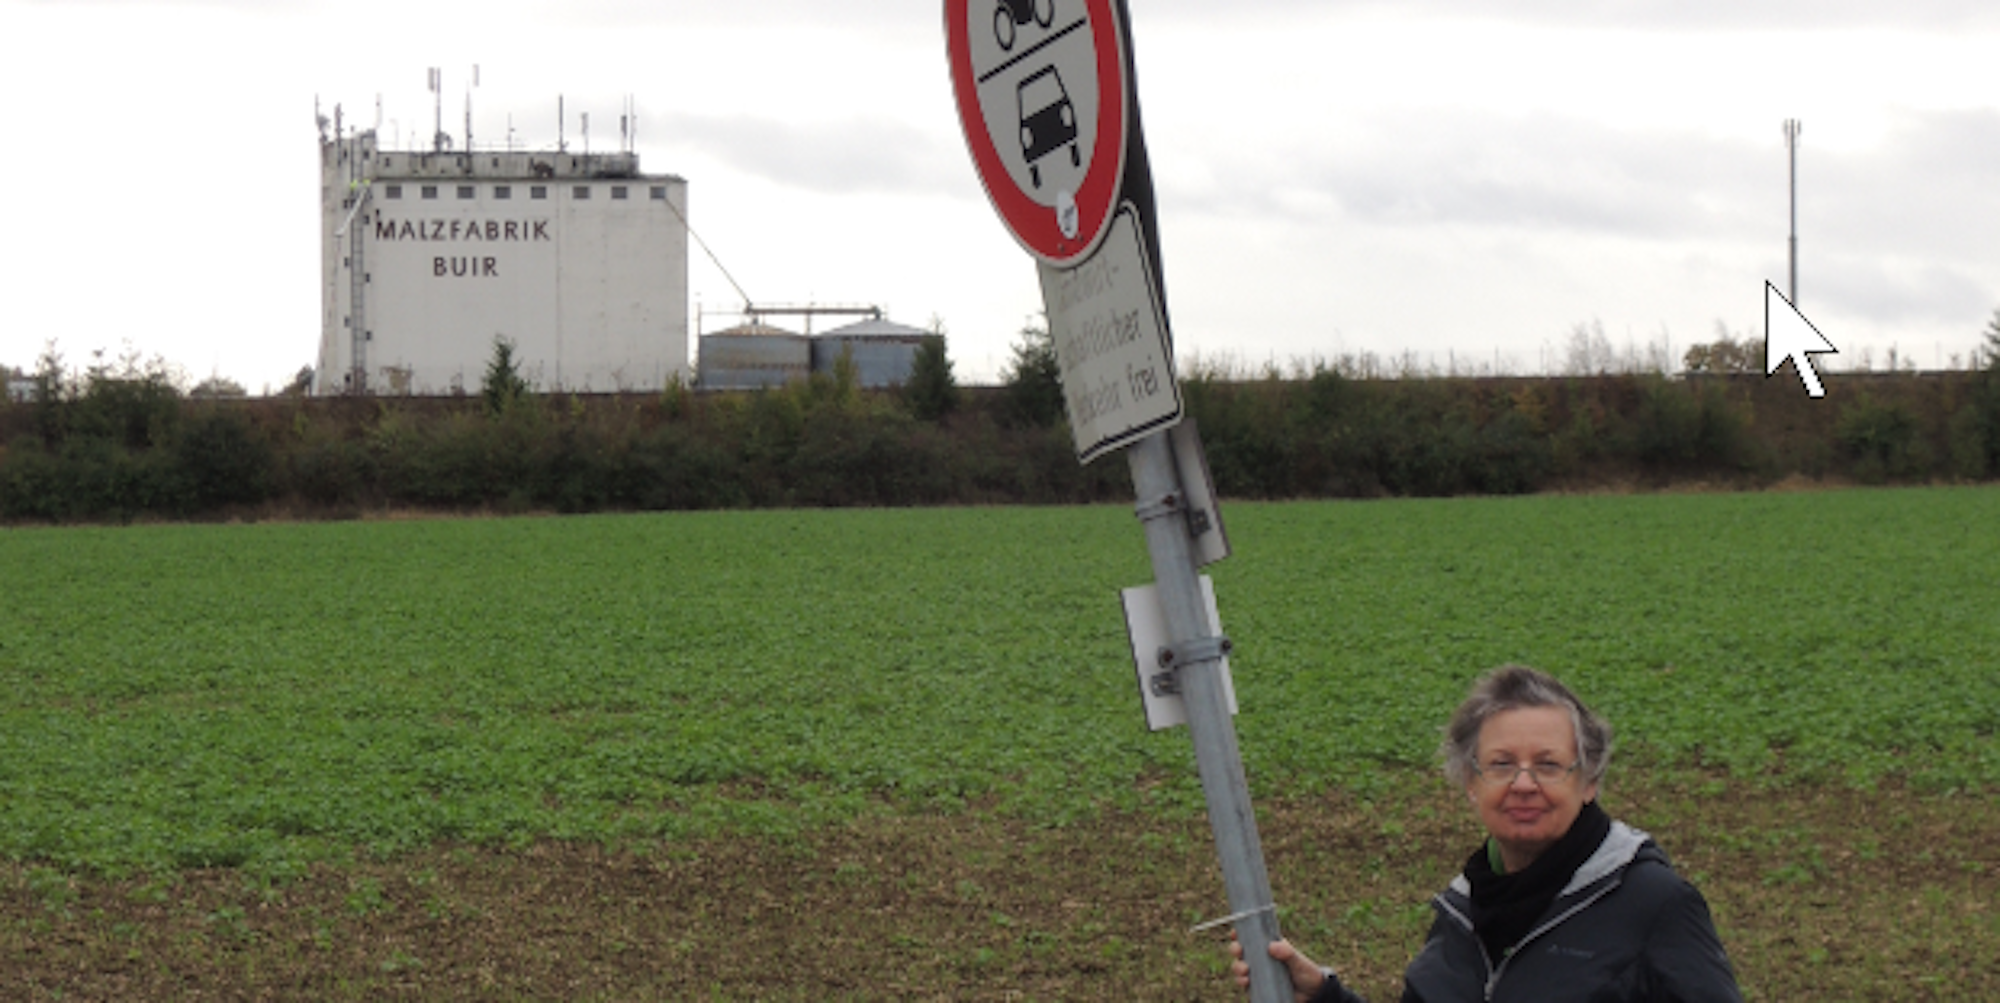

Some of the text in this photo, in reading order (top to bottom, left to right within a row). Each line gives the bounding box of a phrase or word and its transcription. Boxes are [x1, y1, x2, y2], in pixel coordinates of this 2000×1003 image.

[375, 218, 551, 241] MALZFABRIK
[433, 256, 499, 277] BUIR
[1126, 354, 1160, 402] frei
